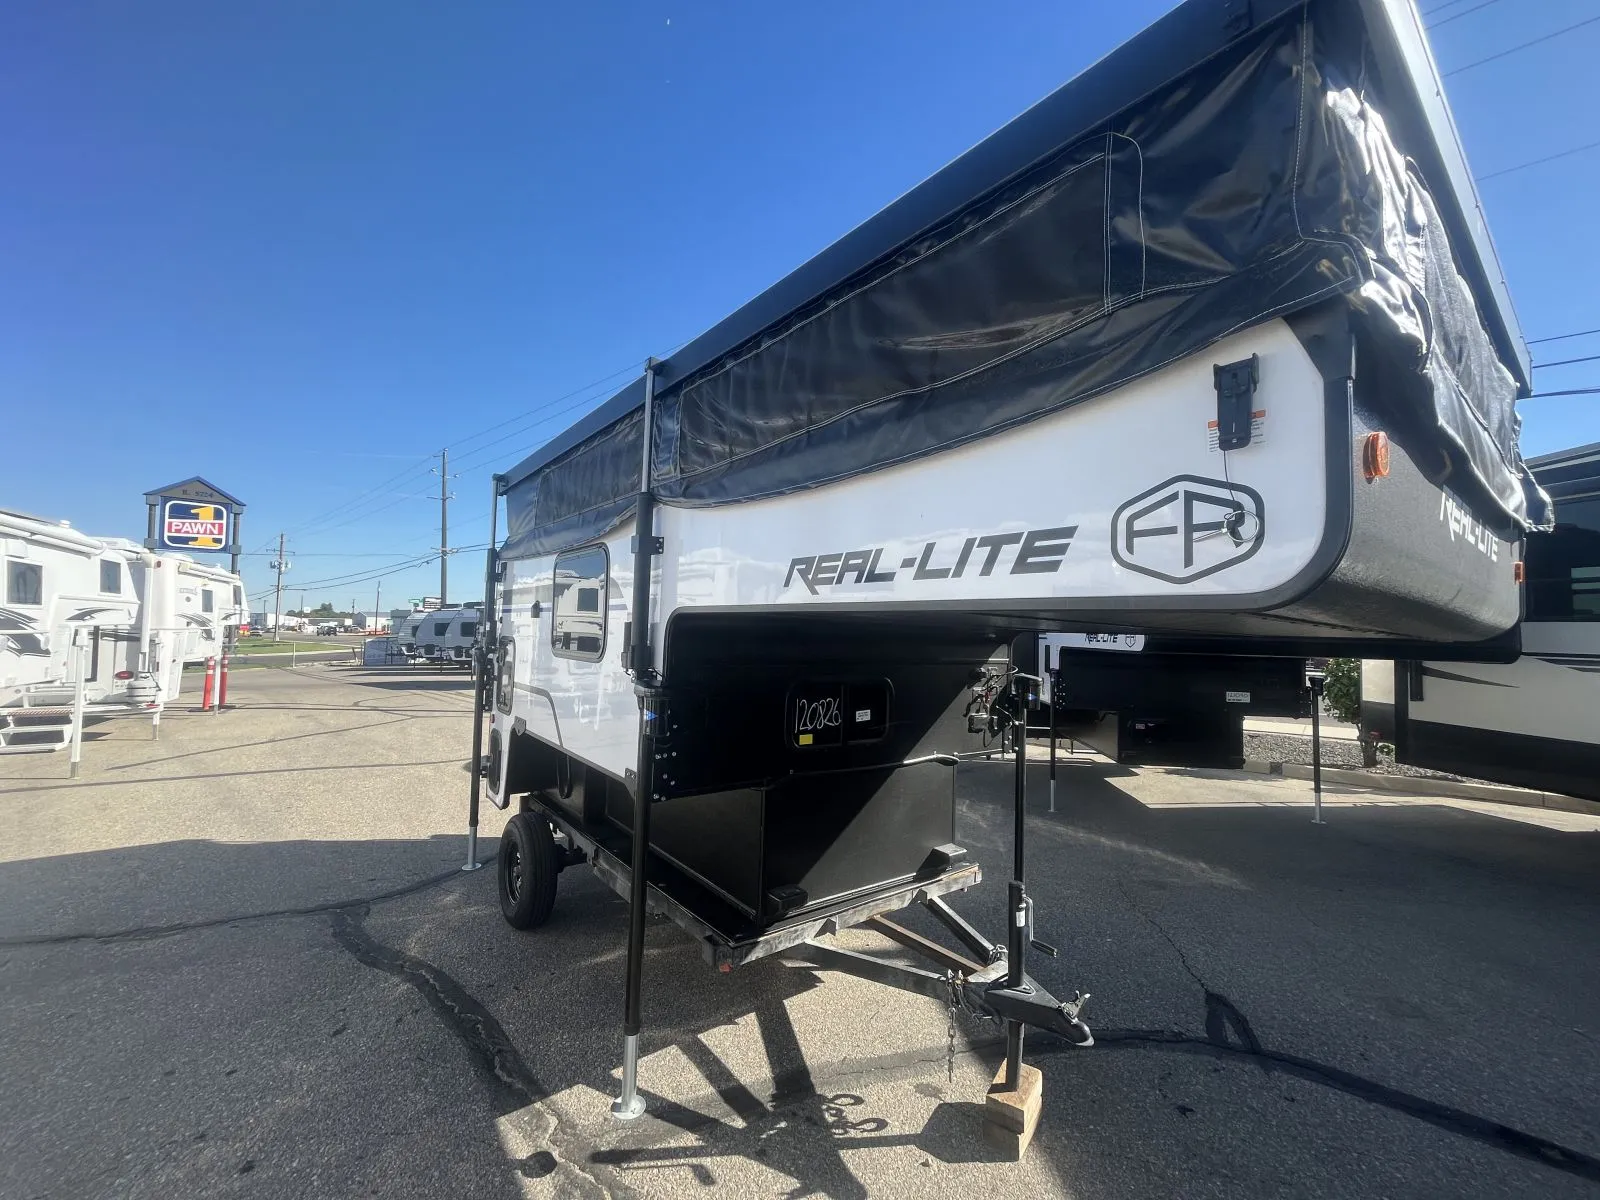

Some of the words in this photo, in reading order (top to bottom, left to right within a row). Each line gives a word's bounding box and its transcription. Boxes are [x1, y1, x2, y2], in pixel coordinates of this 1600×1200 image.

[171, 521, 219, 534] PAWN
[1440, 485, 1498, 562] REAL-LITE
[784, 525, 1079, 595] REAL-LITE
[795, 698, 841, 733] 120826
